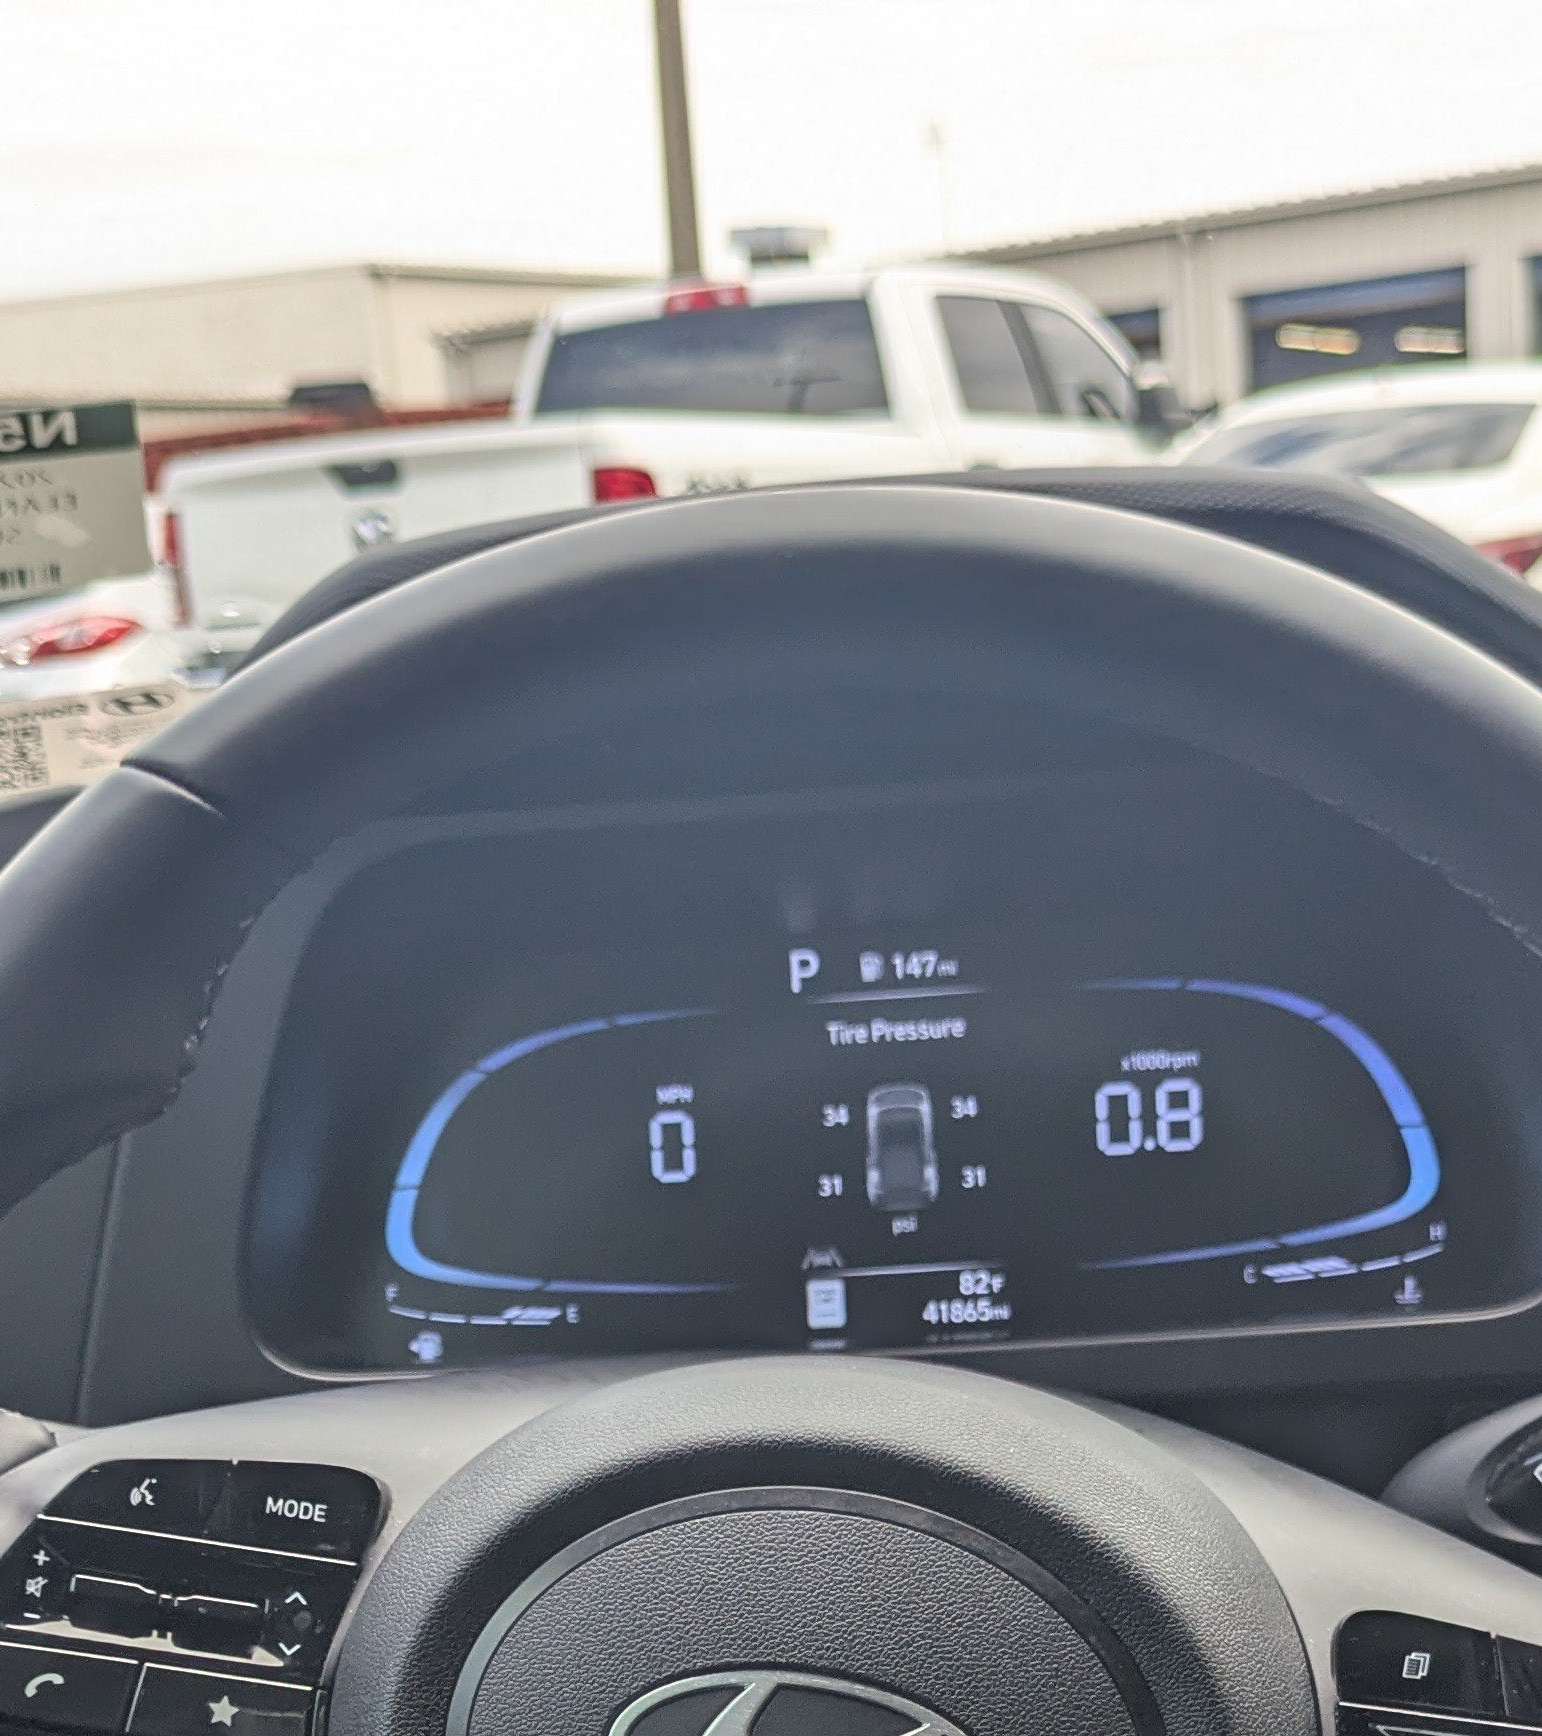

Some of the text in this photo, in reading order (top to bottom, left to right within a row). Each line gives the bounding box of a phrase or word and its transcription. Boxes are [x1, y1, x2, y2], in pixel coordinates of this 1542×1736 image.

[789, 948, 820, 994] P
[826, 1017, 967, 1046] Tire Pressure
[822, 1095, 978, 1127] 34 34
[1095, 1077, 1204, 1157] 0.8
[649, 1110, 696, 1183] 0
[817, 1165, 987, 1197] 31 31
[265, 1497, 328, 1523] MODE
